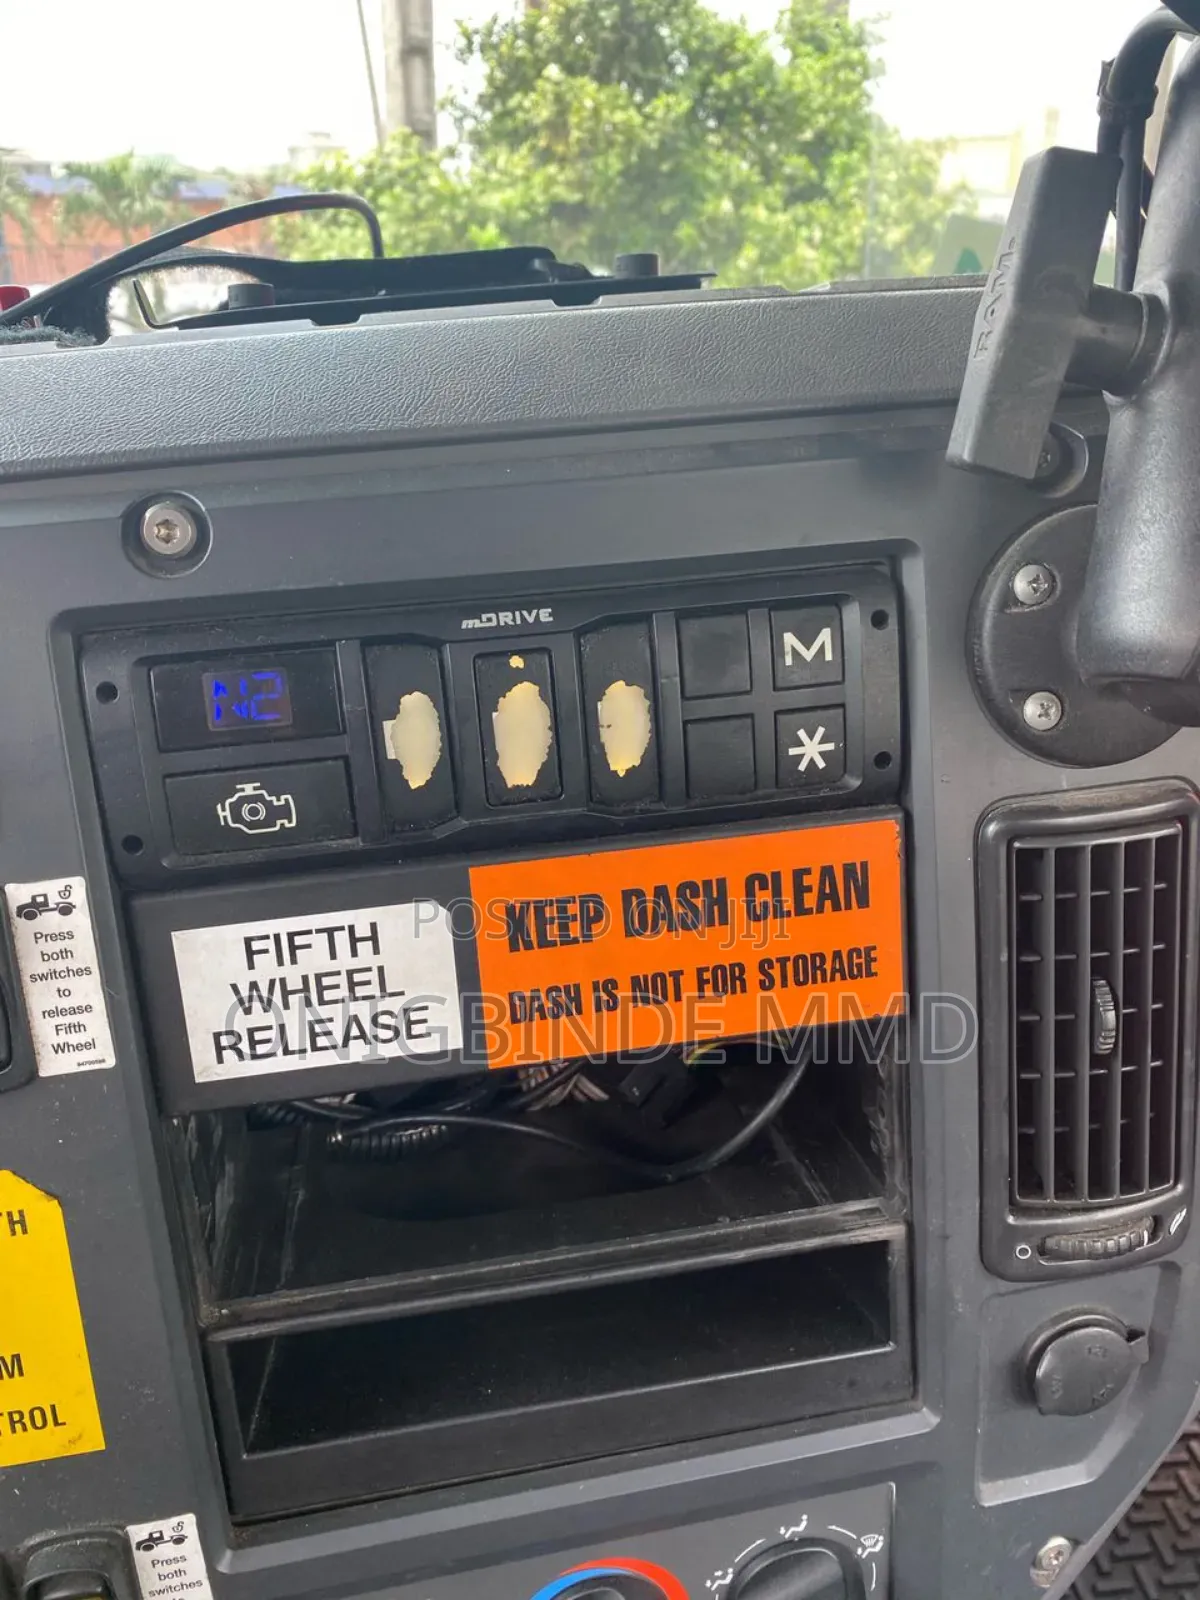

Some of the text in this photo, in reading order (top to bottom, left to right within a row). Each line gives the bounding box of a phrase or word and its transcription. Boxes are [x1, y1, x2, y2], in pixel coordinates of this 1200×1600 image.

[460, 608, 554, 630] mDRIVE
[783, 627, 834, 666] M
[212, 671, 283, 722] N2
[508, 860, 870, 953] KEEP DASH CLEAN
[33, 929, 75, 944] Press
[243, 921, 381, 970] FIFTH
[40, 948, 74, 963] both
[29, 965, 92, 983] switches
[56, 986, 72, 998] to
[230, 965, 406, 1016] WHEEL
[508, 945, 879, 1025] DASH IS NOT FOR STORAGE
[41, 1002, 93, 1019] release
[54, 1021, 87, 1037] Fifth
[212, 1005, 432, 1064] RELEASE
[51, 1038, 96, 1055] Wheel
[0, 1403, 67, 1437] ROL
[151, 1555, 187, 1568] Press
[158, 1569, 187, 1581] both
[148, 1579, 203, 1597] switches
